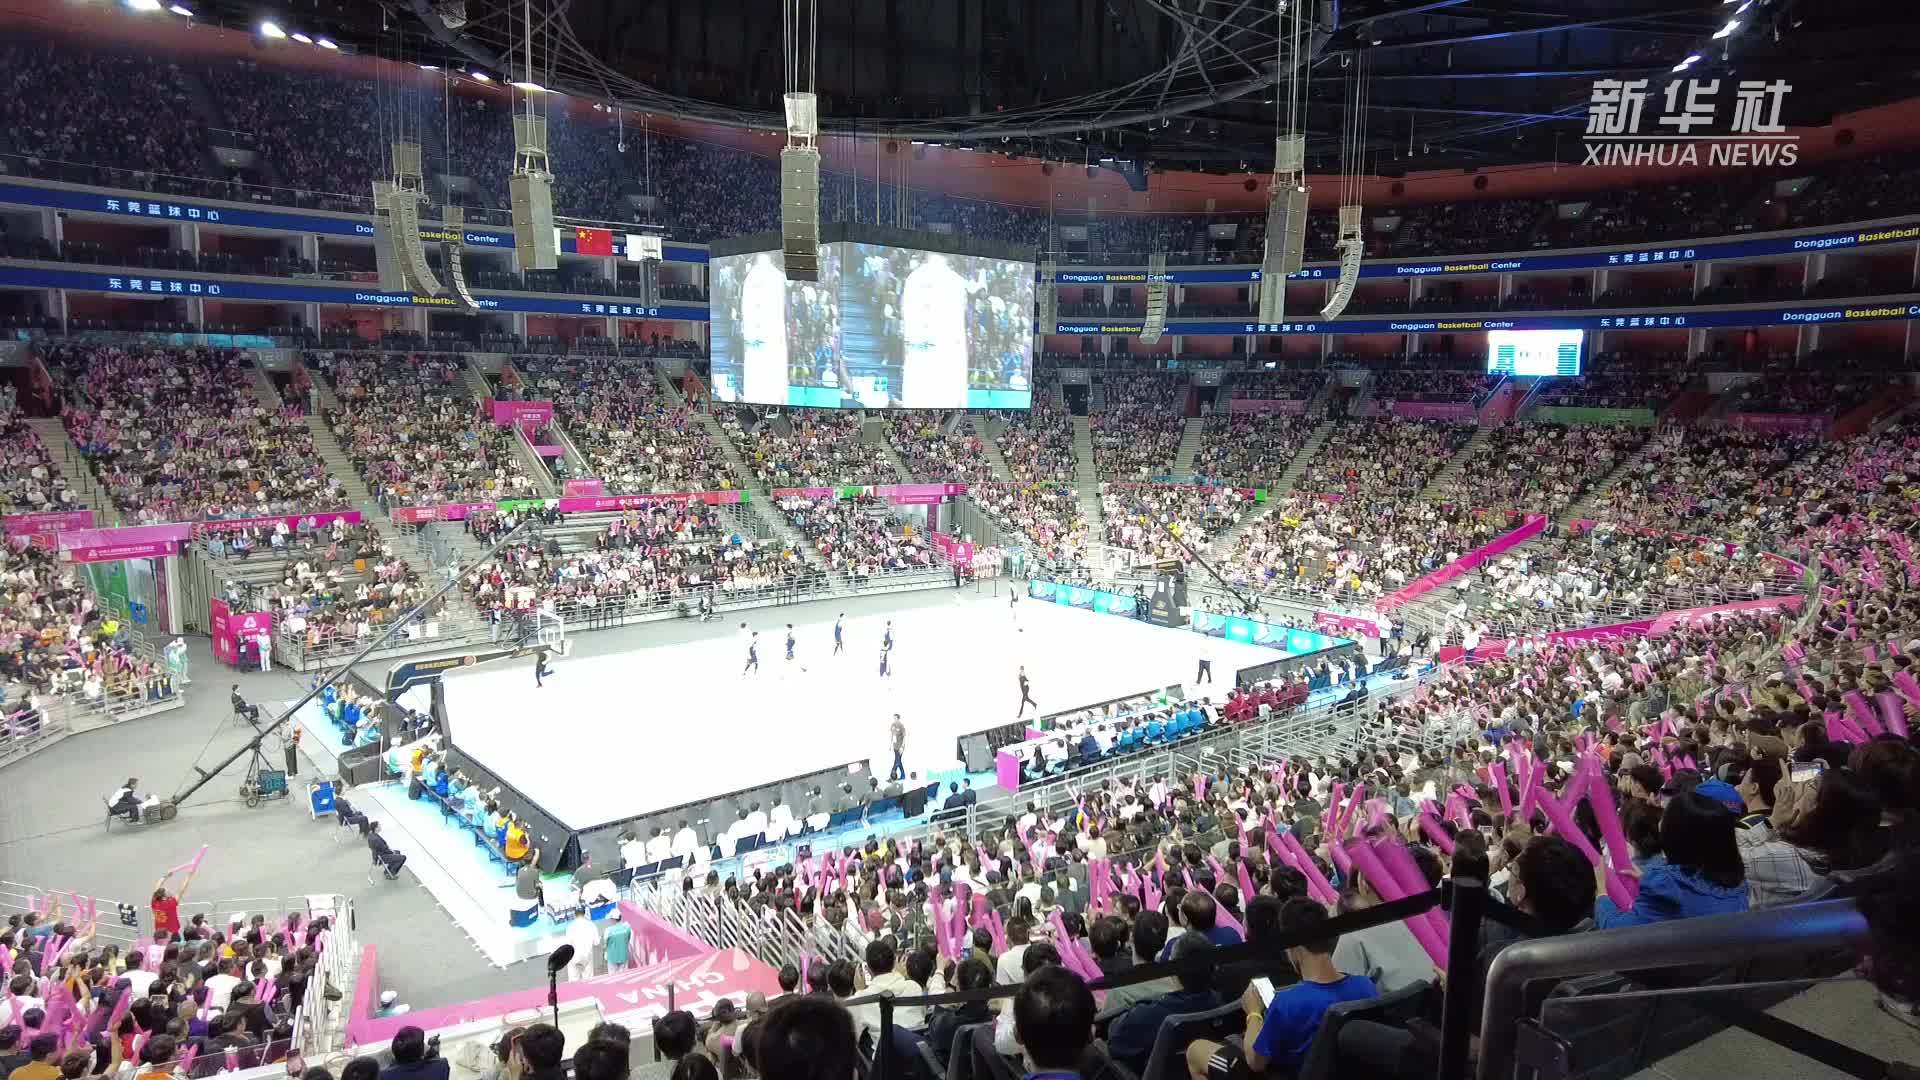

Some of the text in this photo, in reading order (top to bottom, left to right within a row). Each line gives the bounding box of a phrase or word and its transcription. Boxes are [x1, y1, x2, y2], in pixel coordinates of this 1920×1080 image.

[106, 199, 220, 221] 东莞篮球中心
[466, 233, 500, 243] Center
[1793, 227, 1919, 249] Dongguan Basketball
[1397, 261, 1521, 274] Dongguan Basketball Center
[1062, 274, 1104, 282] Dongguan
[355, 293, 409, 303] Dongguan
[1782, 311, 1842, 322] Dongguan
[1845, 307, 1905, 318] Basketball
[1390, 320, 1514, 331] Dongguan Basketball Center
[616, 971, 726, 1004] CHINA
